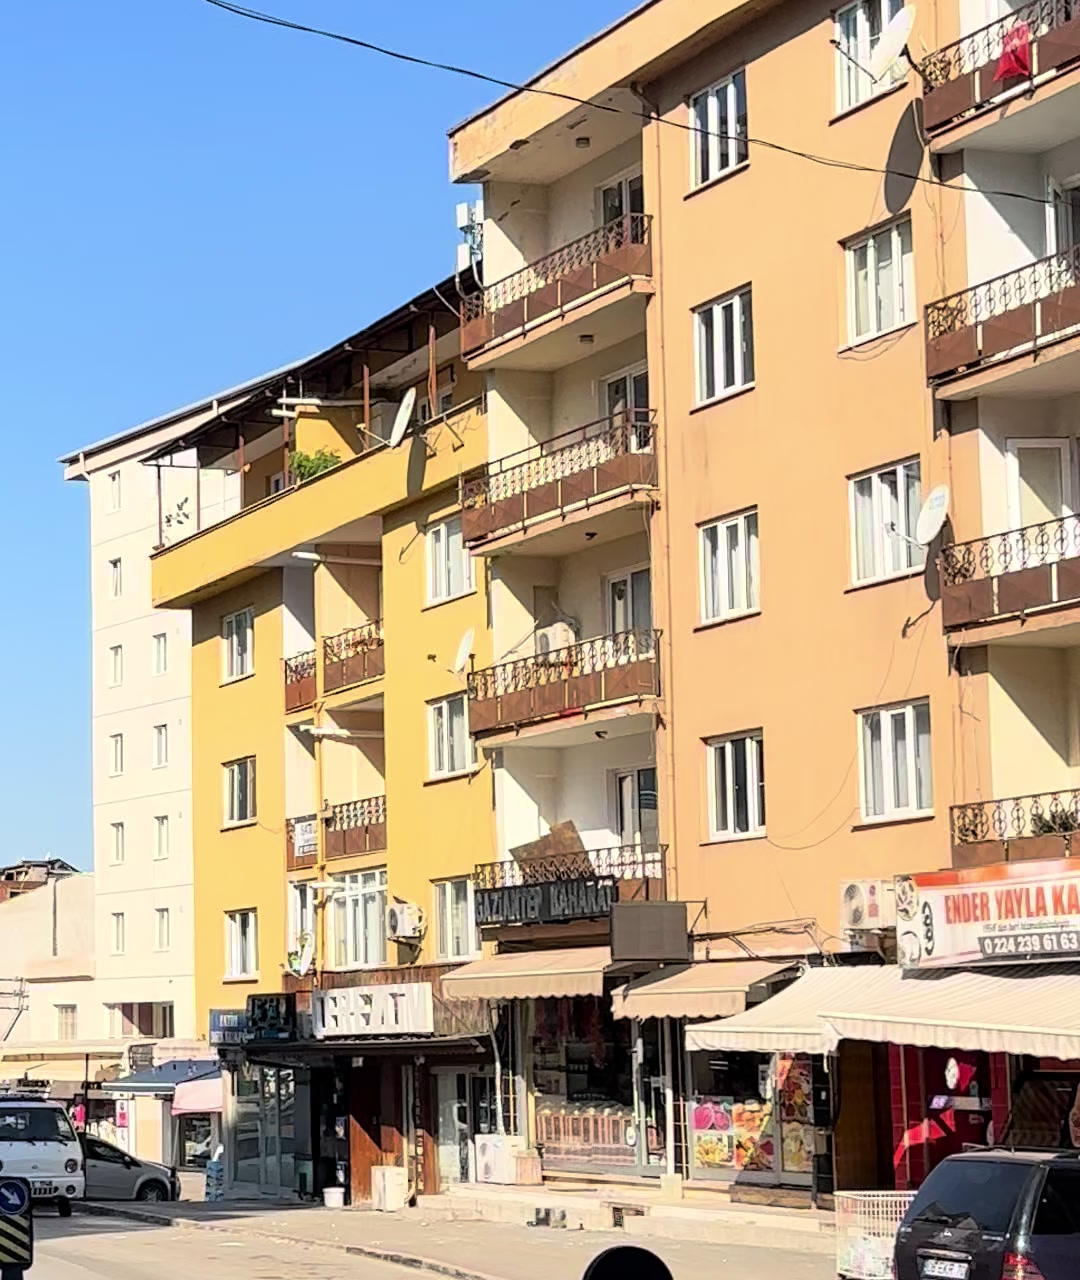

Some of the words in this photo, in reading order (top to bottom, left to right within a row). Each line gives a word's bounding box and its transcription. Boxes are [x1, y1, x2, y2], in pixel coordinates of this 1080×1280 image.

[944, 892, 991, 924] ENDER
[995, 886, 1048, 920] YAYLA
[995, 937, 1016, 953] 224
[1018, 935, 1040, 952] 239
[1043, 934, 1058, 951] 61
[1060, 932, 1078, 950] 63
